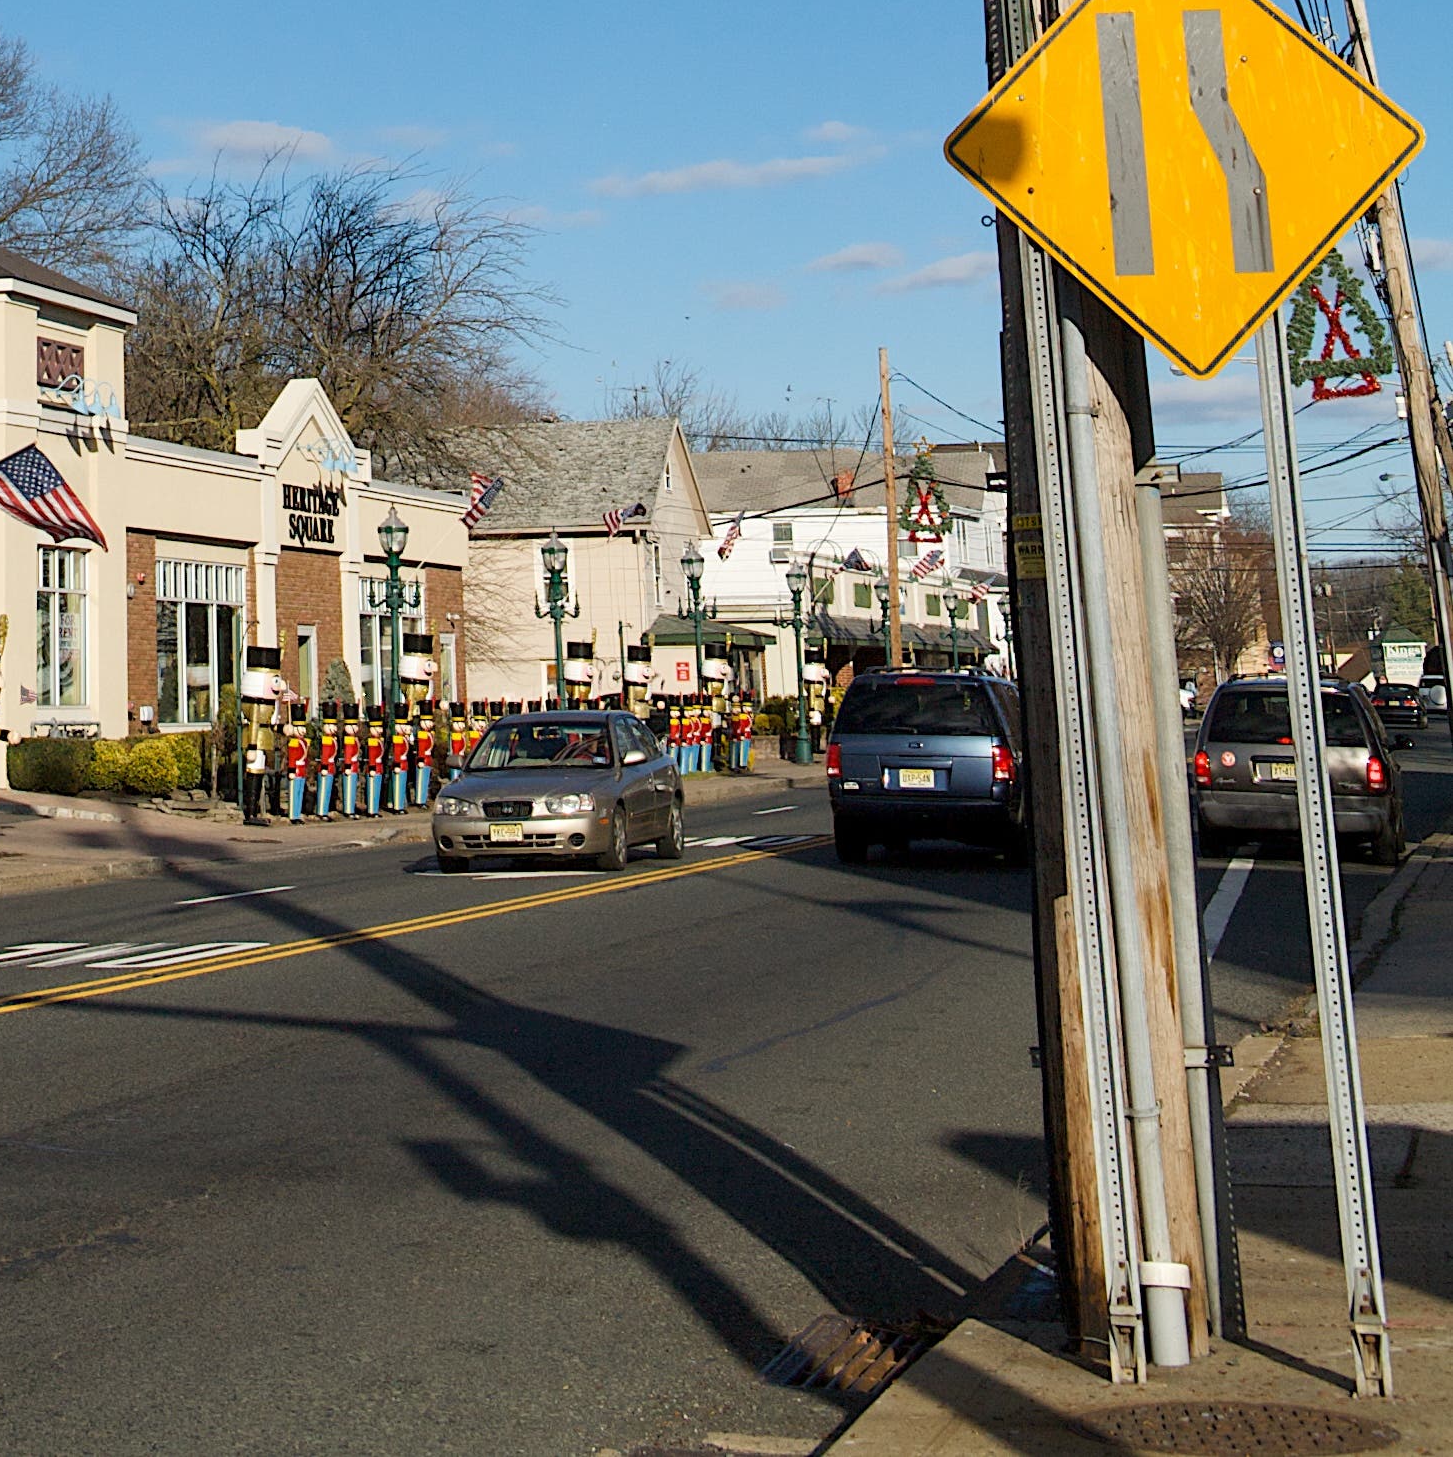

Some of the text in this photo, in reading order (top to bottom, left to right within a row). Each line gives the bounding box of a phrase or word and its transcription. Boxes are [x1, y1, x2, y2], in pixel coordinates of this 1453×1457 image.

[282, 483, 340, 517] HERITAGE
[289, 513, 335, 548] SQUARE
[1387, 643, 1421, 659] Kings
